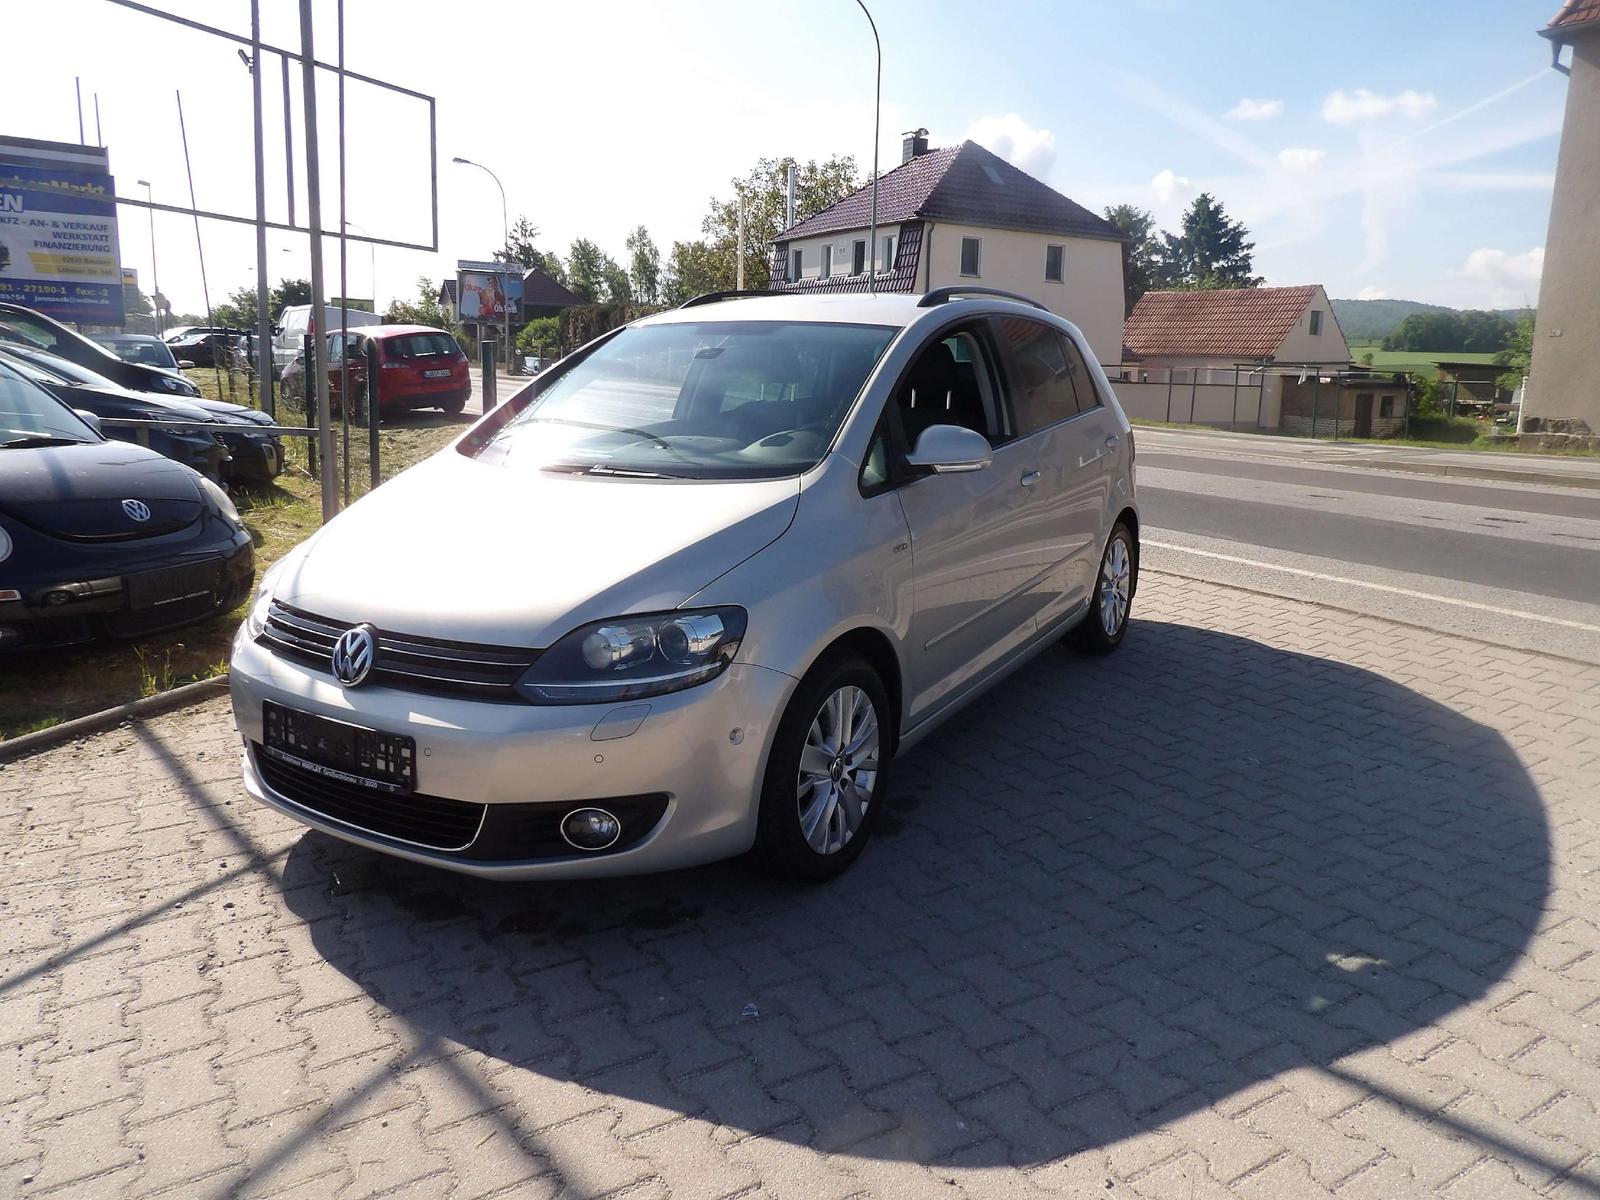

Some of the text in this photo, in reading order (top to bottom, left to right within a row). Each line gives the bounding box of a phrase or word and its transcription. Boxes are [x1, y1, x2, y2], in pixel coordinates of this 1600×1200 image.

[0, 216, 19, 225] KFZ
[62, 222, 109, 232] VERKAUF
[52, 231, 109, 242] WERKSTATT
[34, 240, 111, 253] FINANZIERUNG
[122, 499, 151, 521] VW
[333, 628, 373, 686] VW
